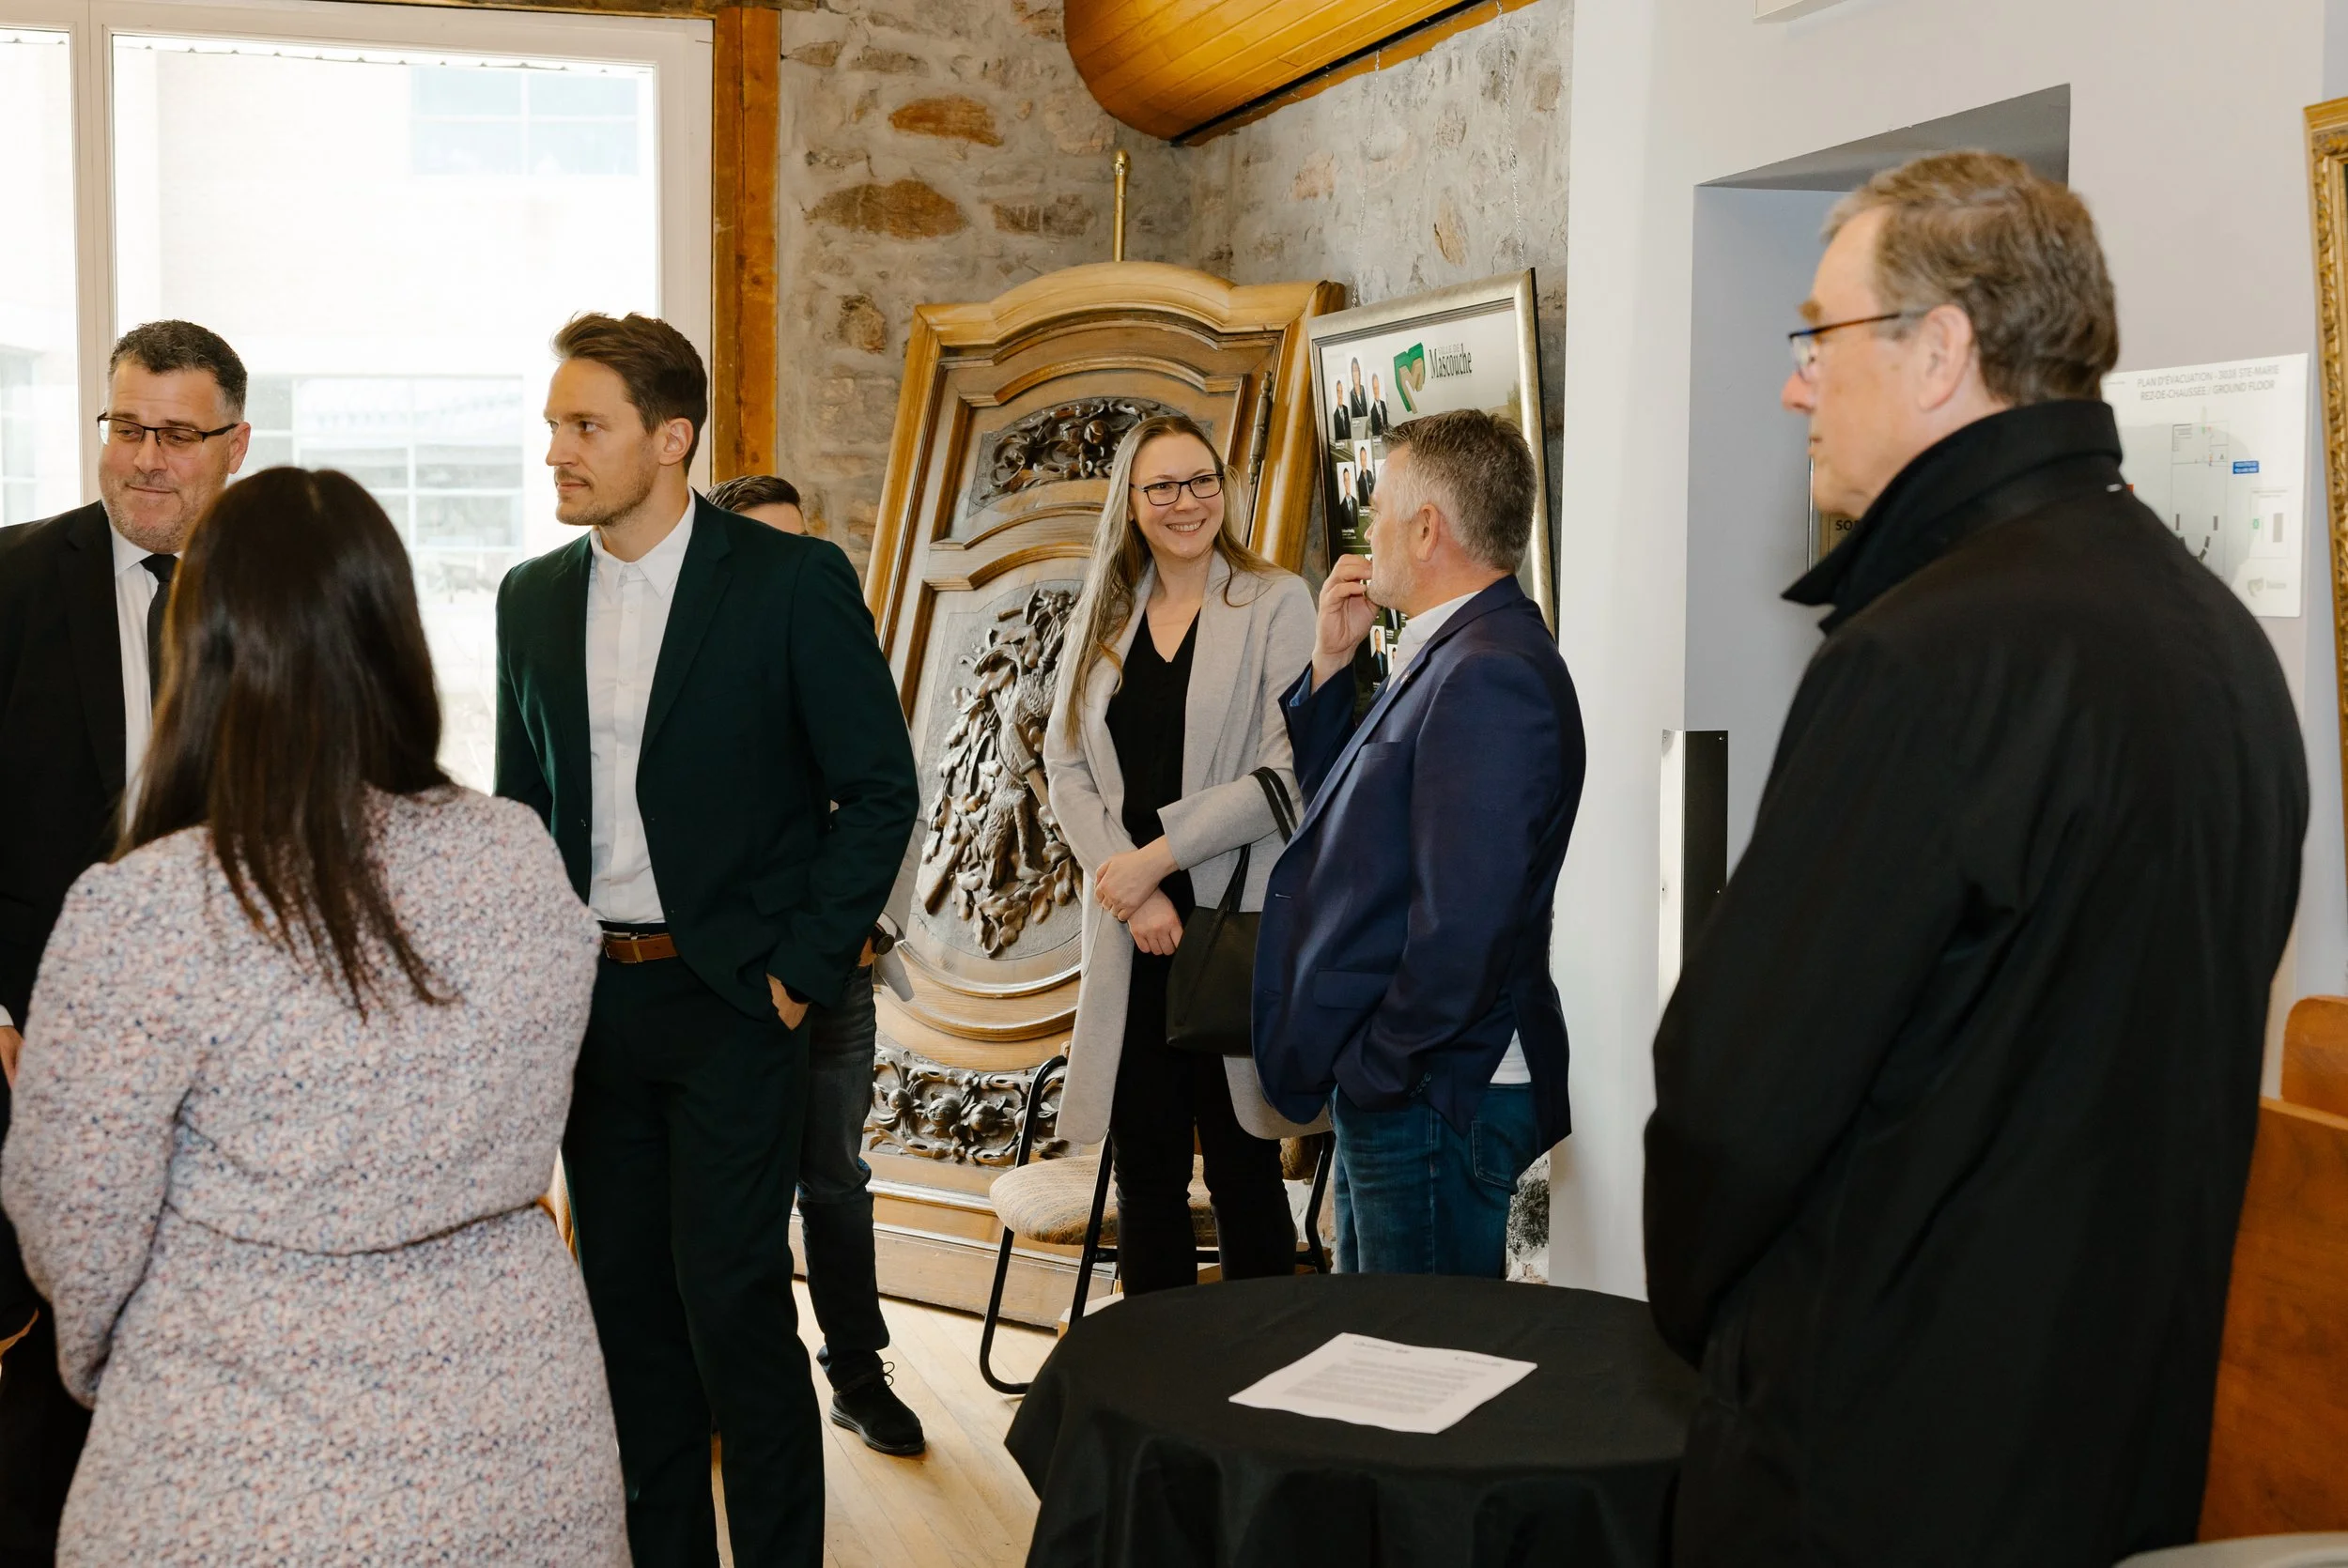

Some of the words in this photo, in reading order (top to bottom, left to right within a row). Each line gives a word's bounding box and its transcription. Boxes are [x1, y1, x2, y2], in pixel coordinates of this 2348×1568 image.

[1429, 343, 1472, 378] Mascouche
[2137, 377, 2156, 388] PLAN
[2157, 371, 2214, 386] D'ÉVACUATION
[2238, 364, 2279, 377] STE-MARIE
[2213, 382, 2247, 395] GROUND
[2248, 379, 2276, 392] FLOOR
